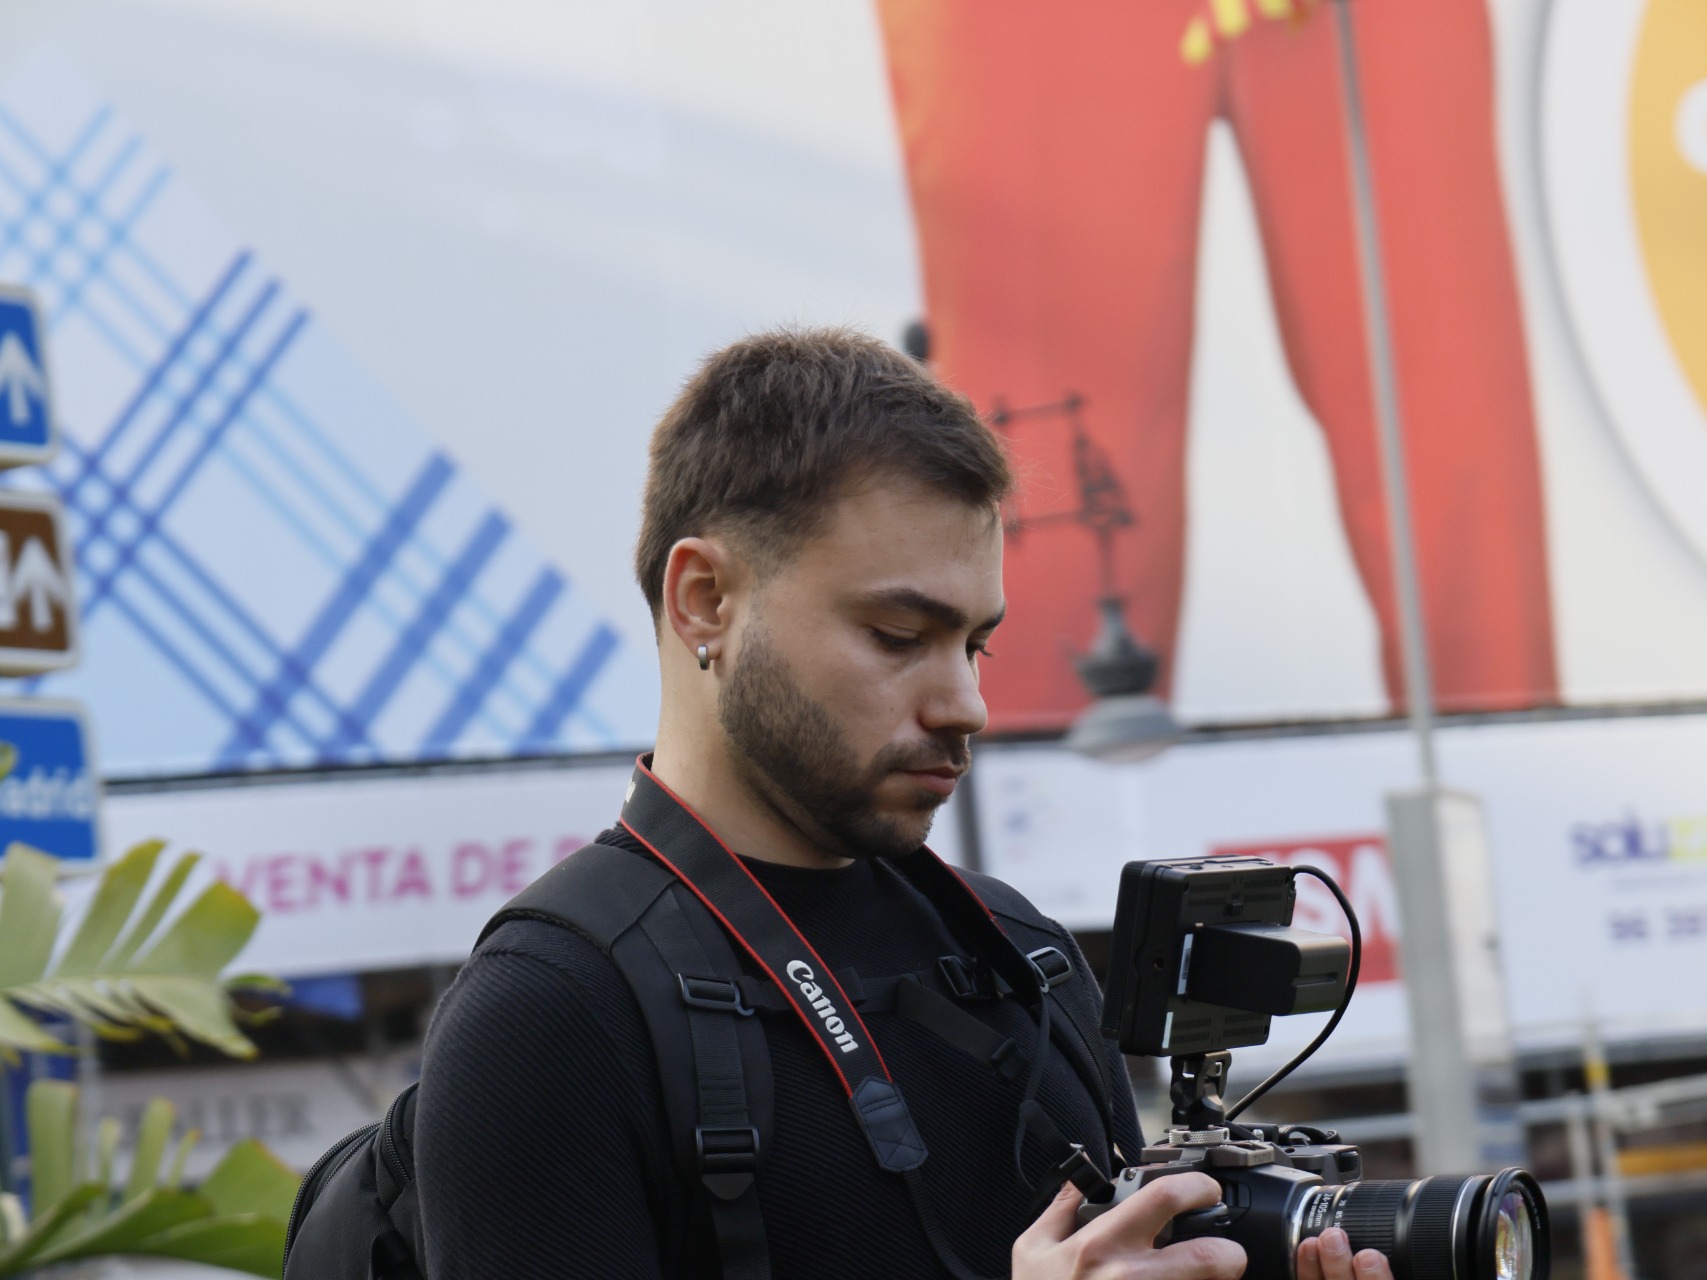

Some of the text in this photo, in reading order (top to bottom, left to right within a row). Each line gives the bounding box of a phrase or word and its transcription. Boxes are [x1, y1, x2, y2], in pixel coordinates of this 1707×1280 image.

[451, 838, 533, 898] DE
[786, 959, 859, 1053] Canon
[1315, 1193, 1333, 1227] 24-105mm
[1335, 1210, 1343, 1219] 85
